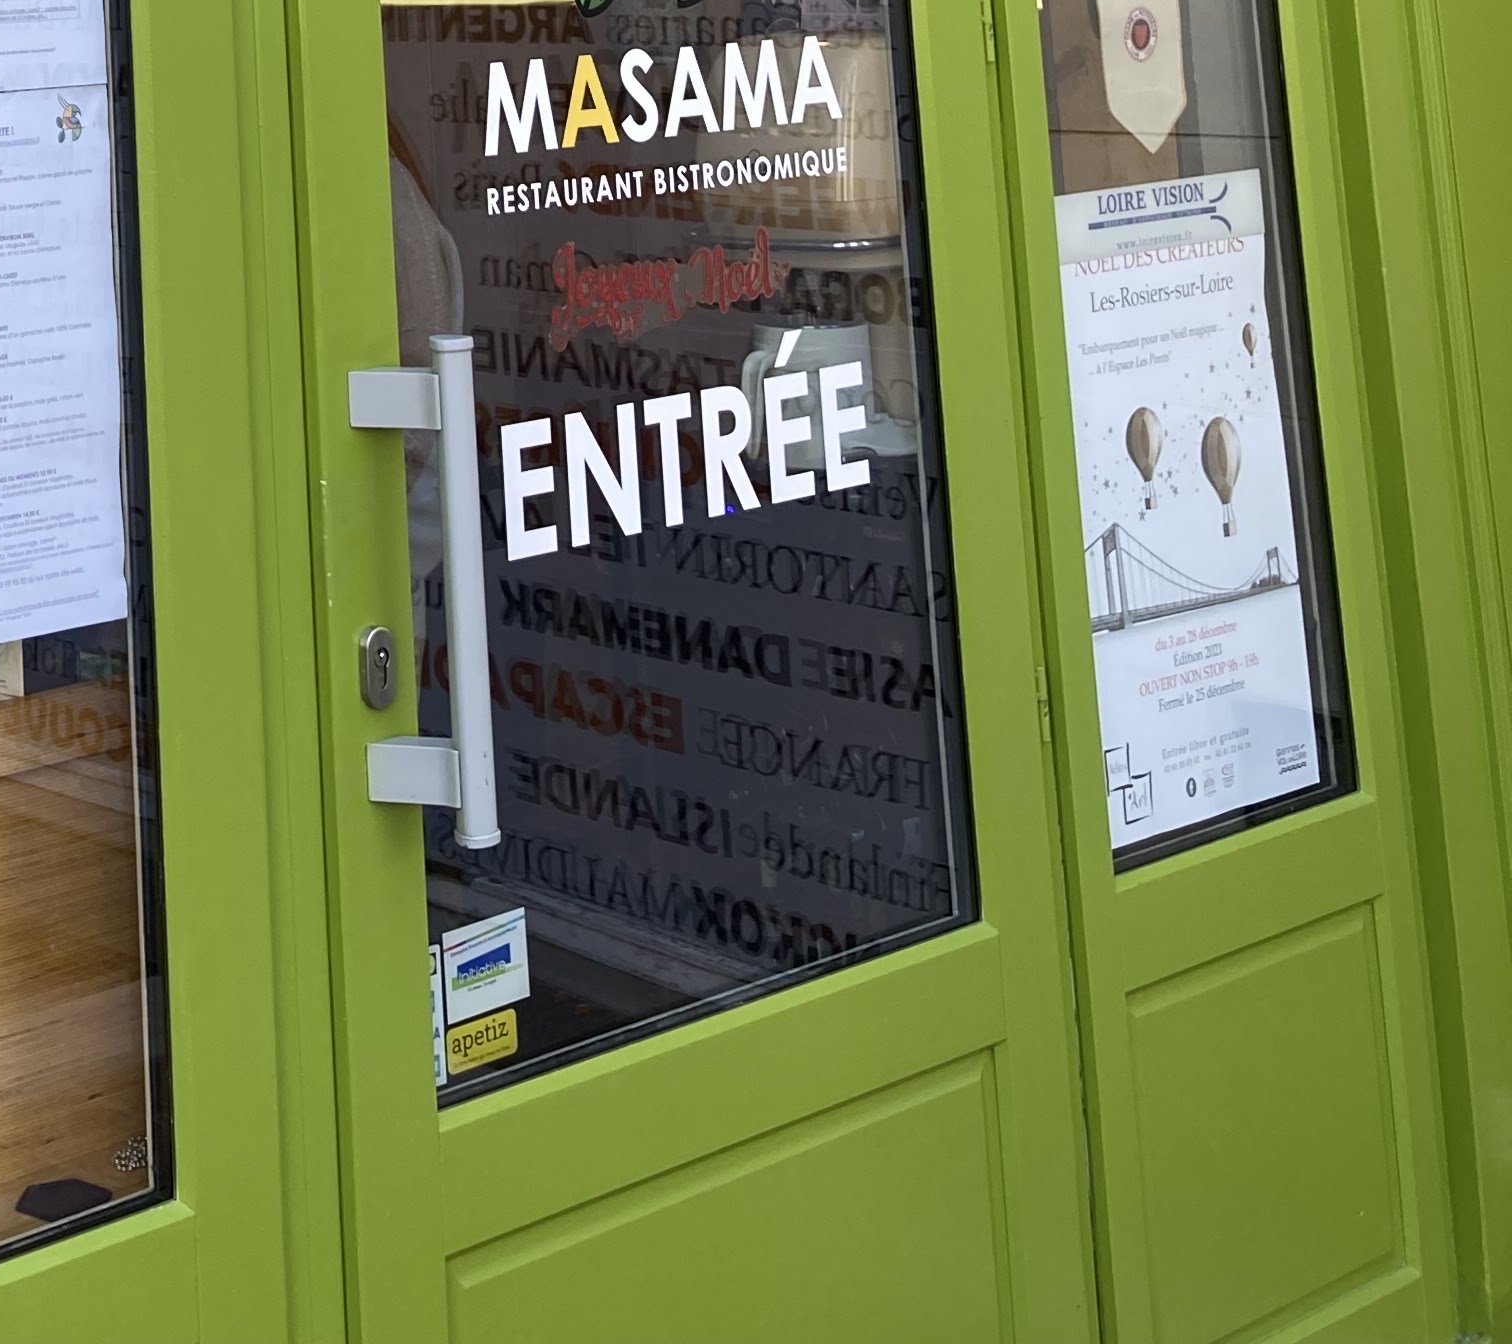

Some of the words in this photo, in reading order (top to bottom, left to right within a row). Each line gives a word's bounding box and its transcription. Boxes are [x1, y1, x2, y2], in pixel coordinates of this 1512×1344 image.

[483, 34, 844, 158] MASAMA
[486, 170, 645, 217] RESTAURANT
[654, 147, 849, 198] BISTRONOMIQUE
[1096, 190, 1147, 215] LOIRE
[1151, 181, 1205, 208] VISION
[549, 239, 680, 350] Joyeux
[1089, 271, 1235, 313] Les-Rosiers-sur-Loire
[499, 329, 871, 562] ENTRÉE
[1154, 636, 1169, 653] du
[1169, 634, 1175, 649] 3
[1175, 635, 1187, 647] au
[1198, 620, 1238, 643] décembre
[1173, 647, 1204, 668] Édition
[1139, 674, 1180, 697] OUVERT
[1179, 666, 1203, 686] NON
[1202, 661, 1227, 681] STOP
[1158, 692, 1186, 713] Fermé
[1186, 689, 1194, 705] le
[1206, 678, 1246, 700] décembre
[451, 1017, 510, 1058] apetiz
